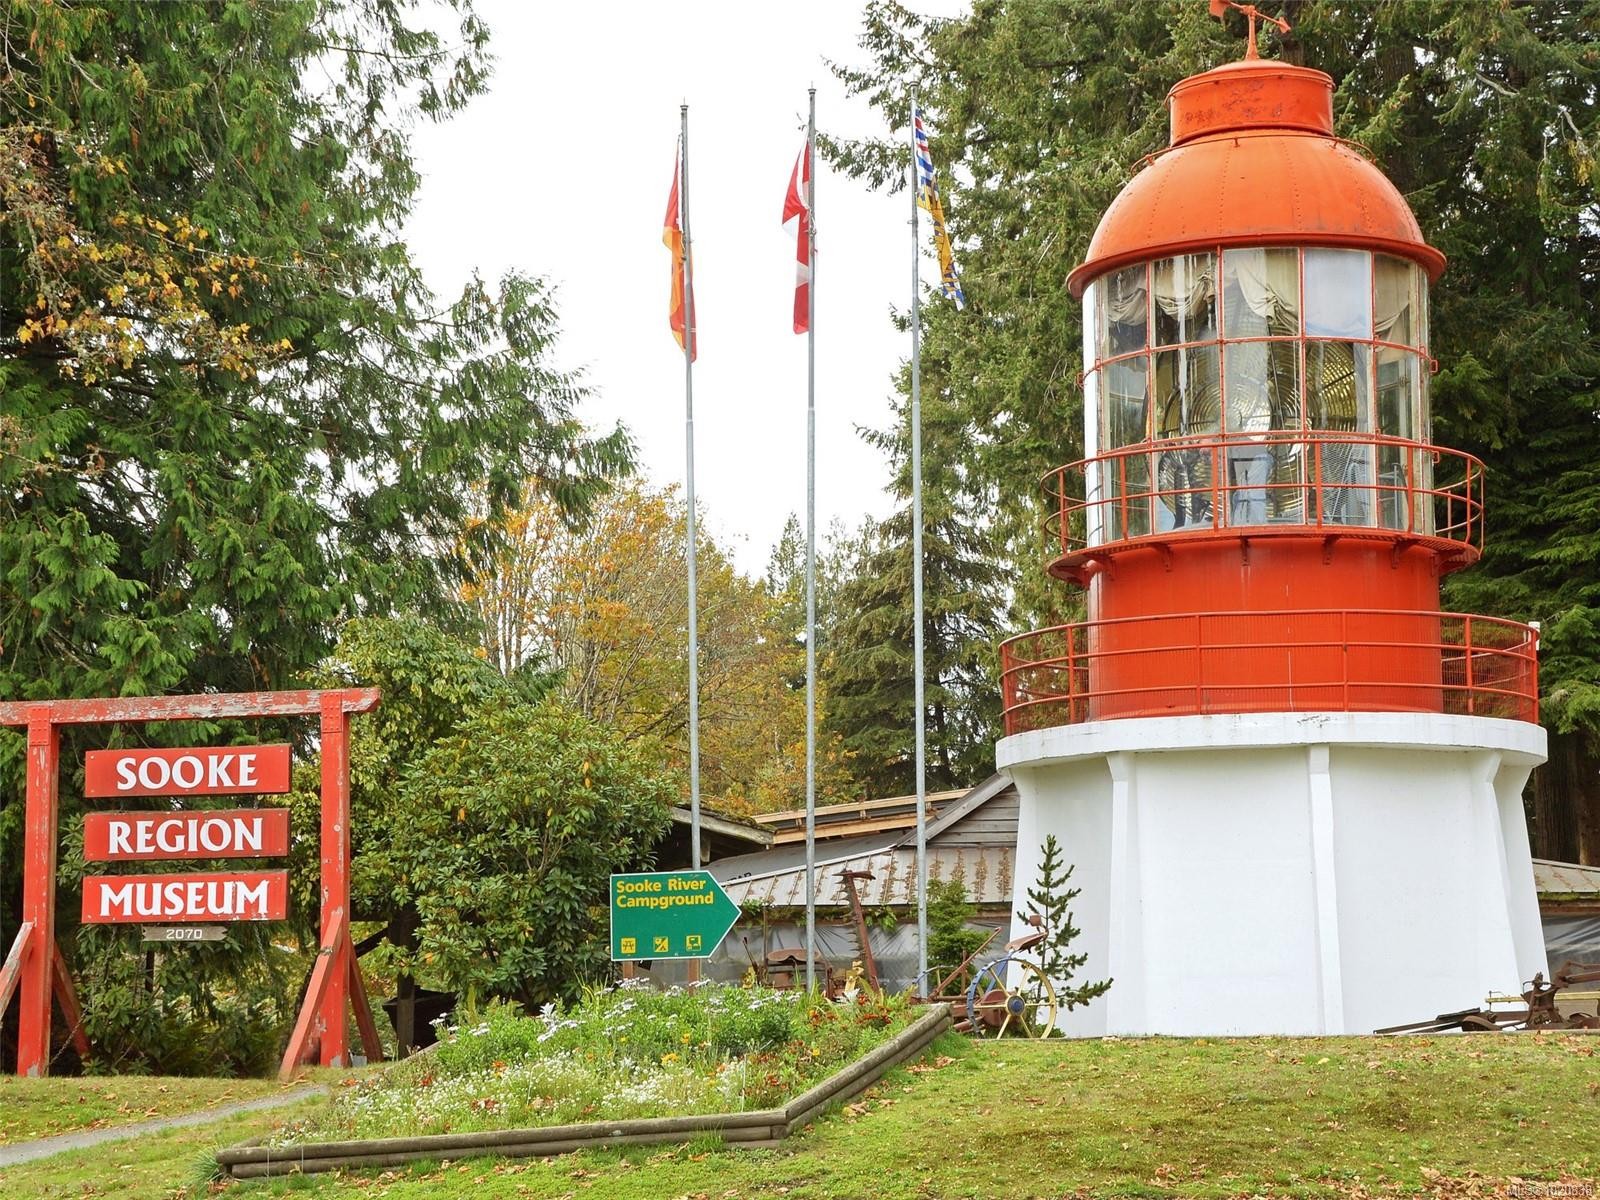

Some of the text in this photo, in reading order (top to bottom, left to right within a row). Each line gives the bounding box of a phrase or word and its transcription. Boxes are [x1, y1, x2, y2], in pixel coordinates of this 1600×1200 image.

[116, 754, 258, 791] SOOKE
[108, 818, 263, 854] REGION
[100, 880, 270, 917] MUSEUM
[616, 878, 707, 893] Sooke River
[616, 891, 714, 909] Campground
[166, 929, 203, 940] 2070
